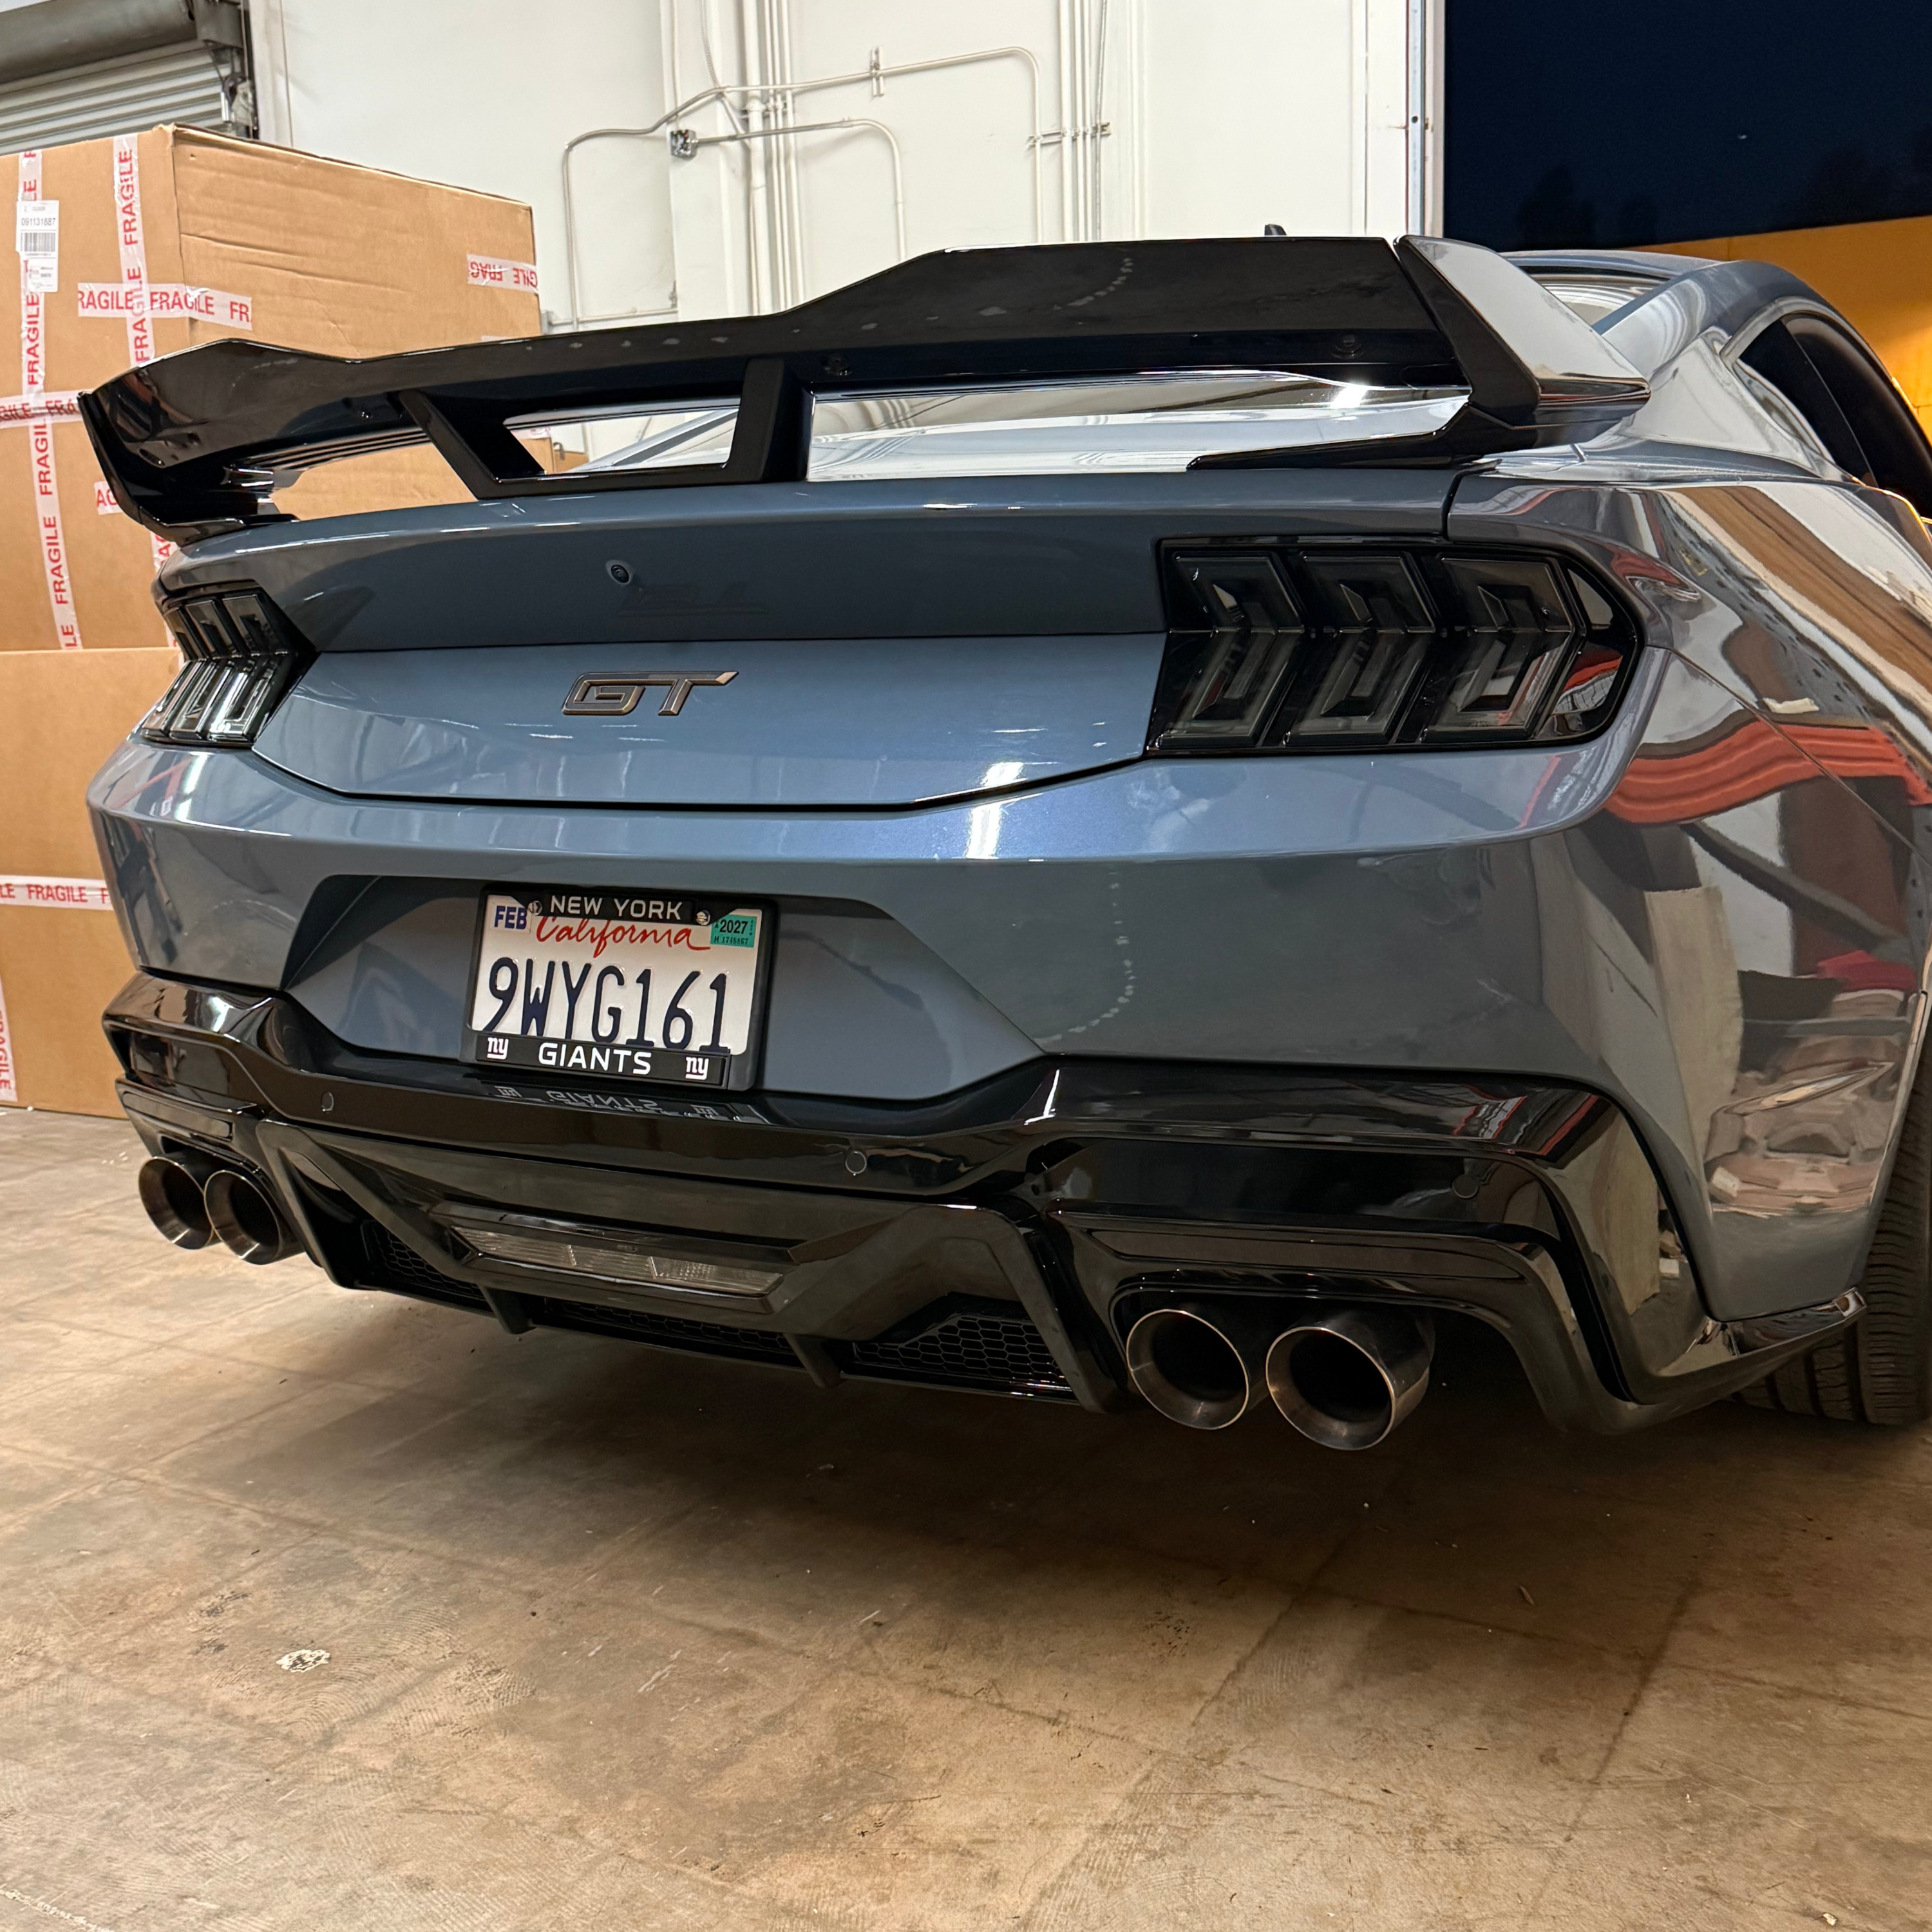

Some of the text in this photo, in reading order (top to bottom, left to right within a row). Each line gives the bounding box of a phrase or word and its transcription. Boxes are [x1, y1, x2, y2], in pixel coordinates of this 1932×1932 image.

[118, 149, 138, 245] FRAGILE
[128, 267, 149, 362] FRAGILE
[150, 290, 214, 315] FRAGILE
[26, 294, 39, 385] FRAGILE
[33, 419, 53, 495] FRAGIL
[43, 516, 67, 604] FRAGILE
[562, 671, 739, 715] GT
[26, 884, 88, 903] FRAGILE
[551, 895, 682, 921] NEW YORK
[494, 905, 528, 930] FEB
[536, 916, 711, 958] California
[719, 919, 748, 934] 2027
[482, 957, 731, 1054] 9WYG161
[538, 1042, 652, 1075] GIANTS
